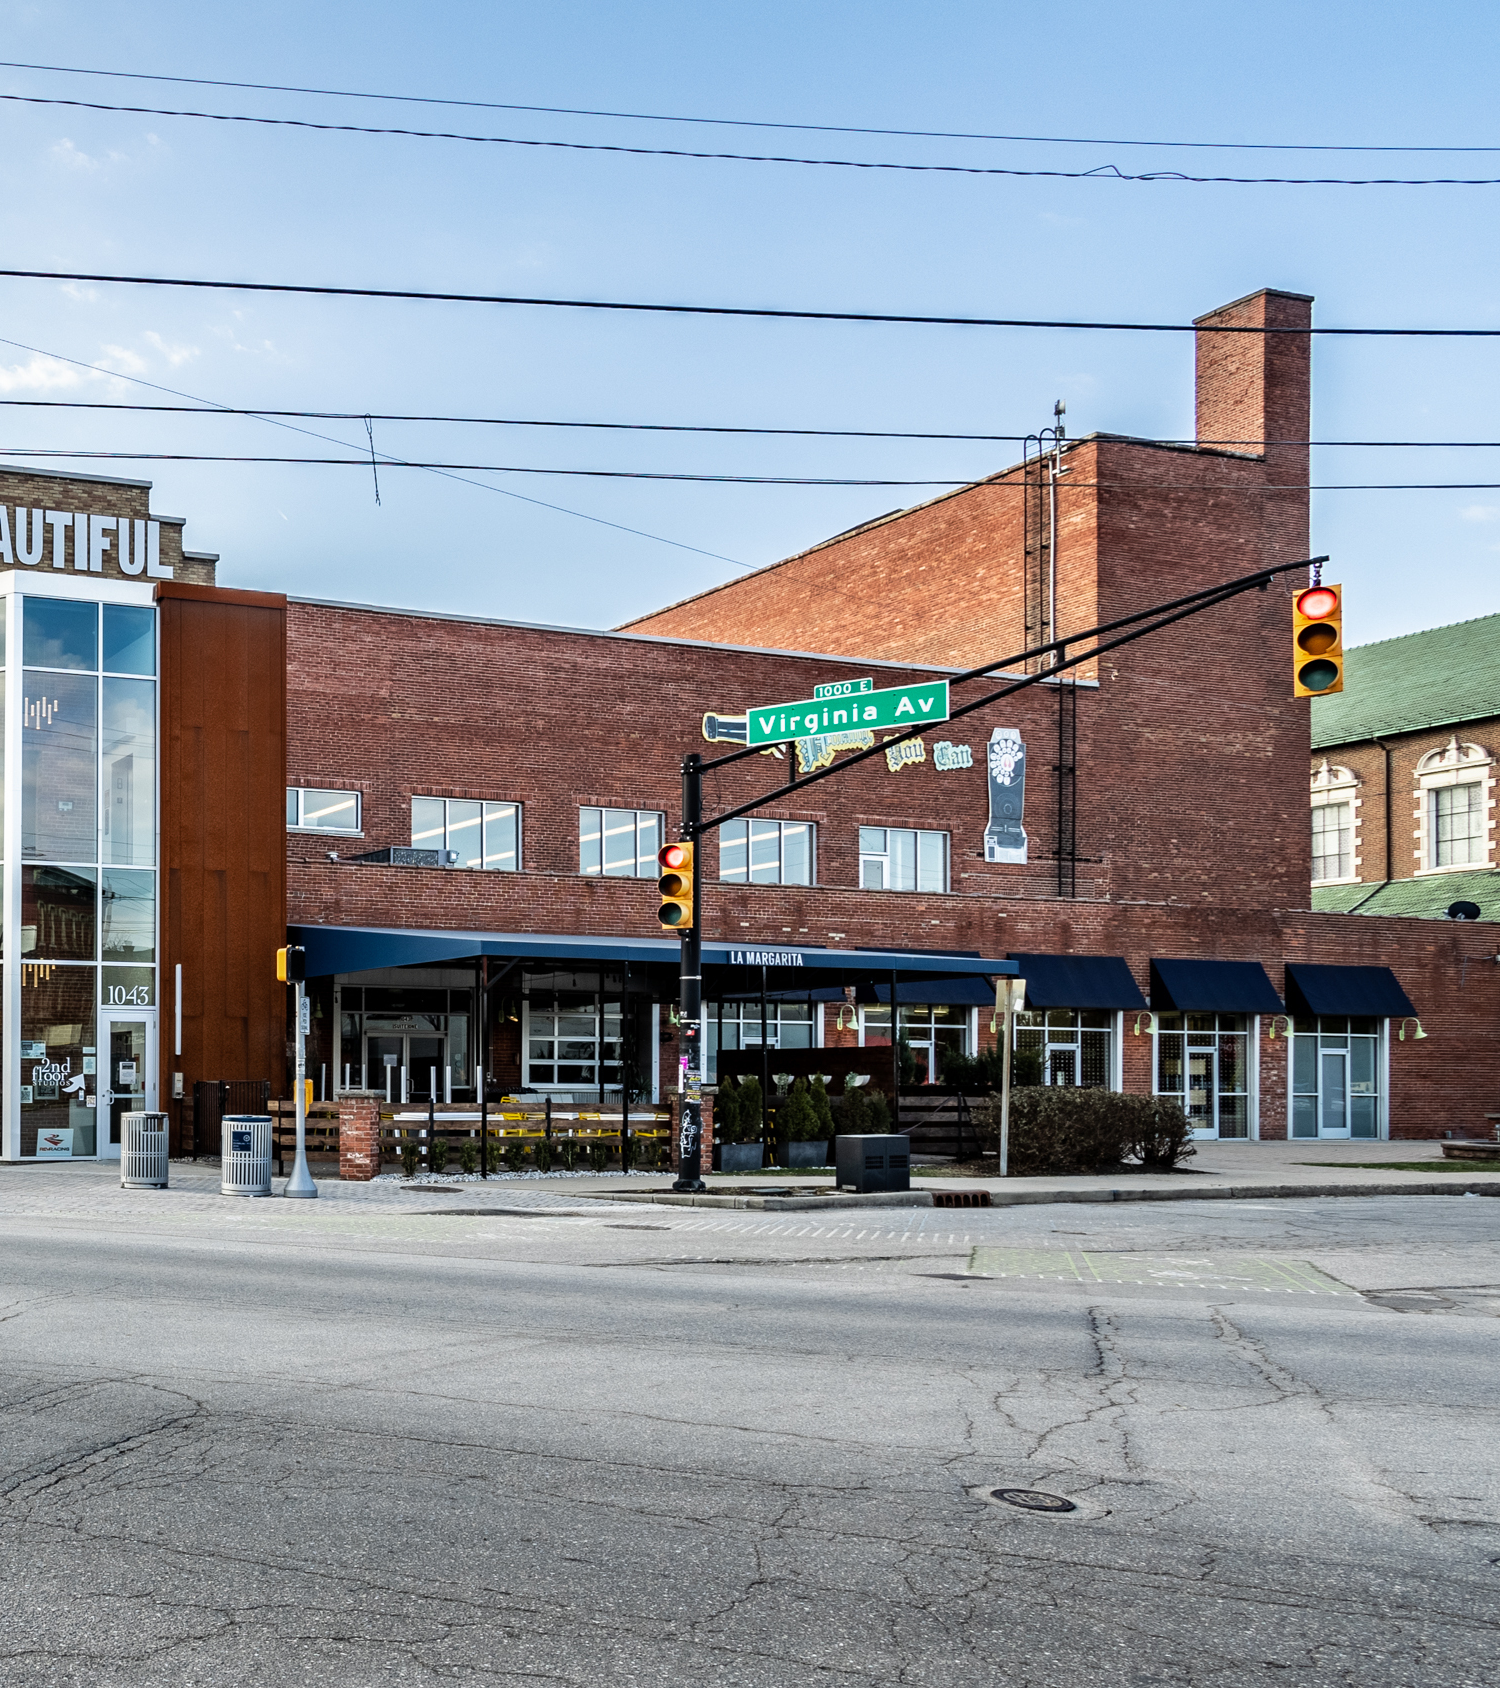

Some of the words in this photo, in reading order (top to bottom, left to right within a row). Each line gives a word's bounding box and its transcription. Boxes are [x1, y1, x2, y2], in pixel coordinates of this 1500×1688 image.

[818, 683, 851, 697] 1000
[860, 680, 868, 692] E
[758, 703, 878, 734] Virginia
[894, 696, 935, 717] Av
[730, 950, 744, 965] LA
[746, 951, 804, 967] MARGARITA
[107, 984, 150, 1006] 1043
[41, 1056, 71, 1073] 2nd
[32, 1066, 68, 1081] floor
